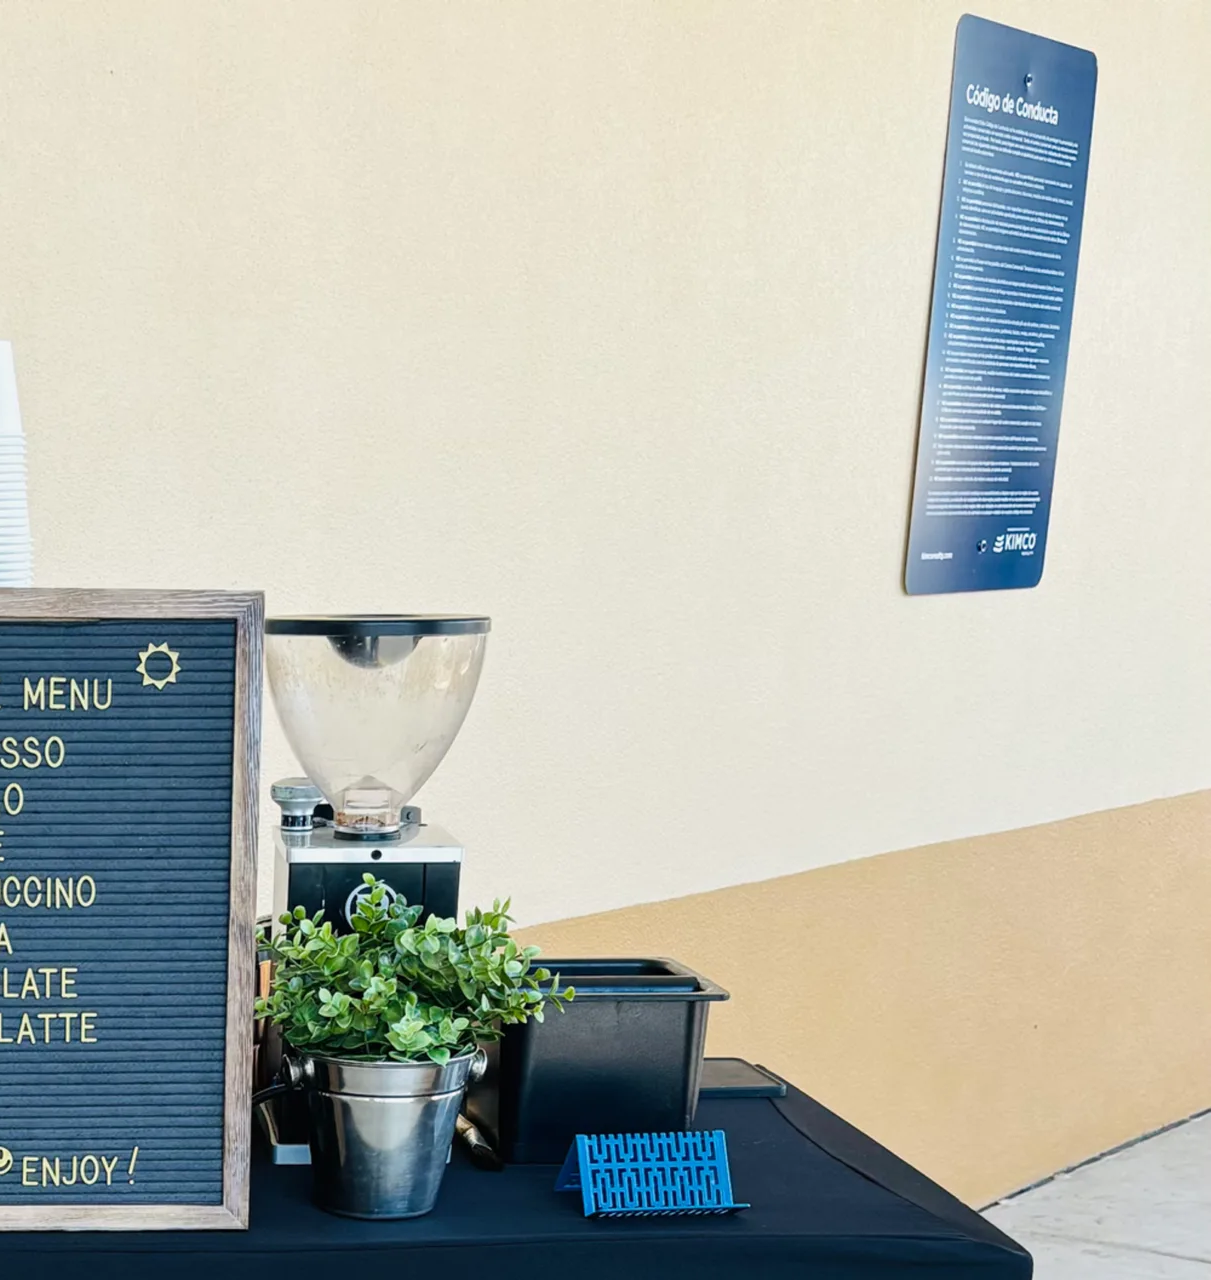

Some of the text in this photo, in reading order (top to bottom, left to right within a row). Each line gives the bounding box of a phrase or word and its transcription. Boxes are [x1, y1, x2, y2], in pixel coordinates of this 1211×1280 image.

[966, 84, 1058, 125] Código de Conducta
[1005, 533, 1036, 551] KIMCO
[23, 676, 112, 711] MENU
